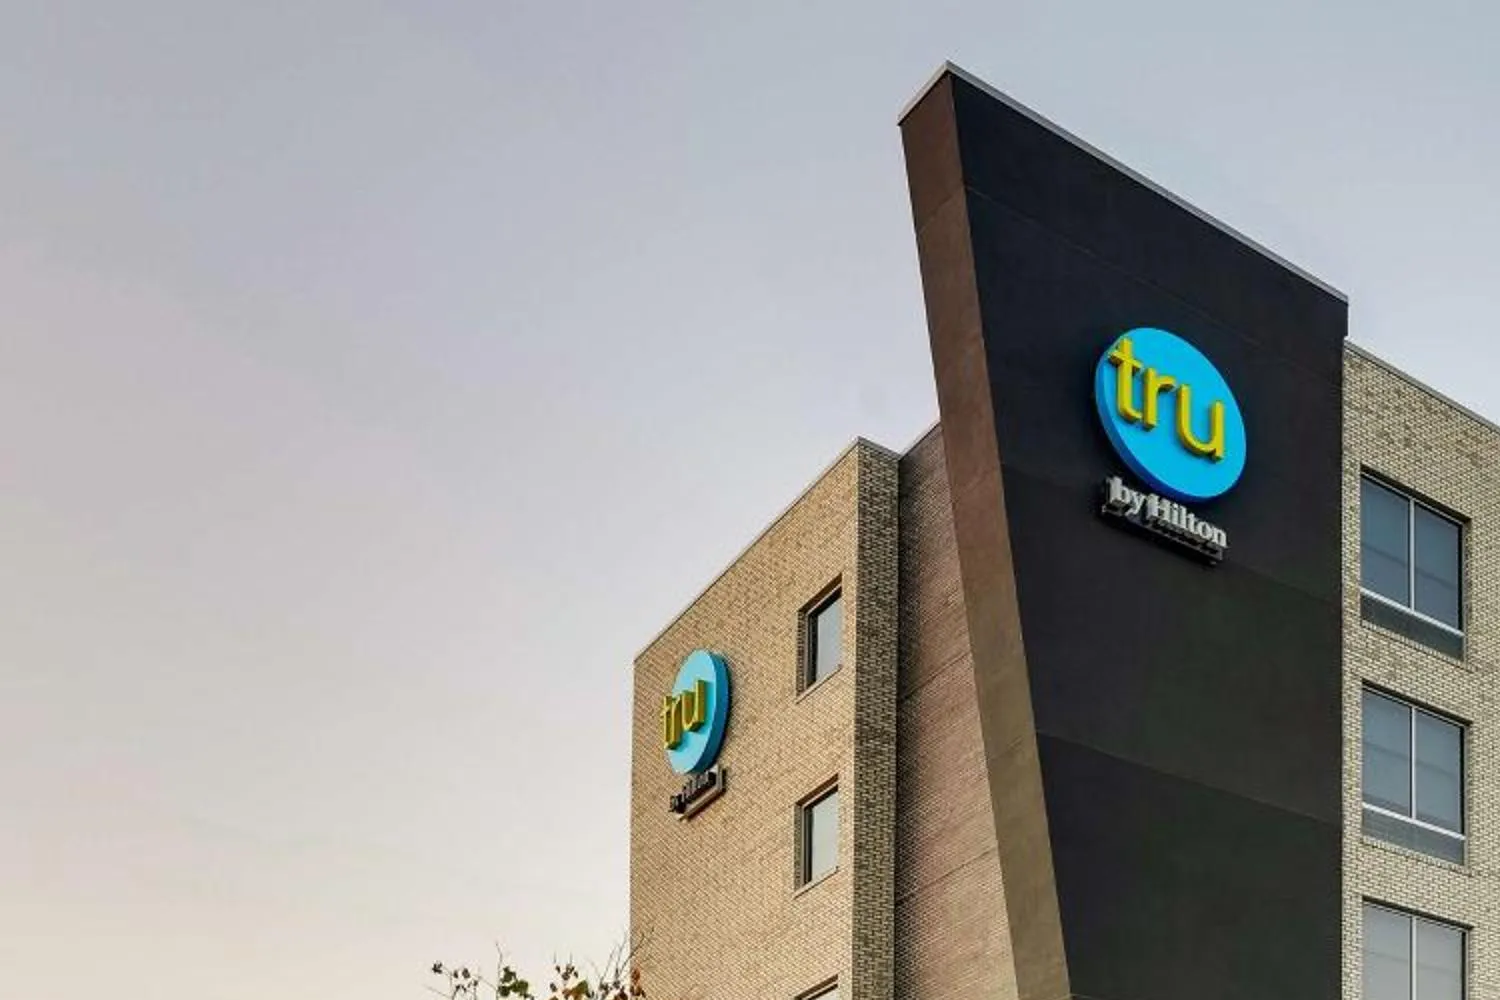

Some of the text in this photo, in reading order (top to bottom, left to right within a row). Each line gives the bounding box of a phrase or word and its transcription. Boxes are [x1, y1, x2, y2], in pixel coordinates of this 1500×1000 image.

[1108, 337, 1226, 462] tru
[1107, 476, 1228, 549] by Hilton
